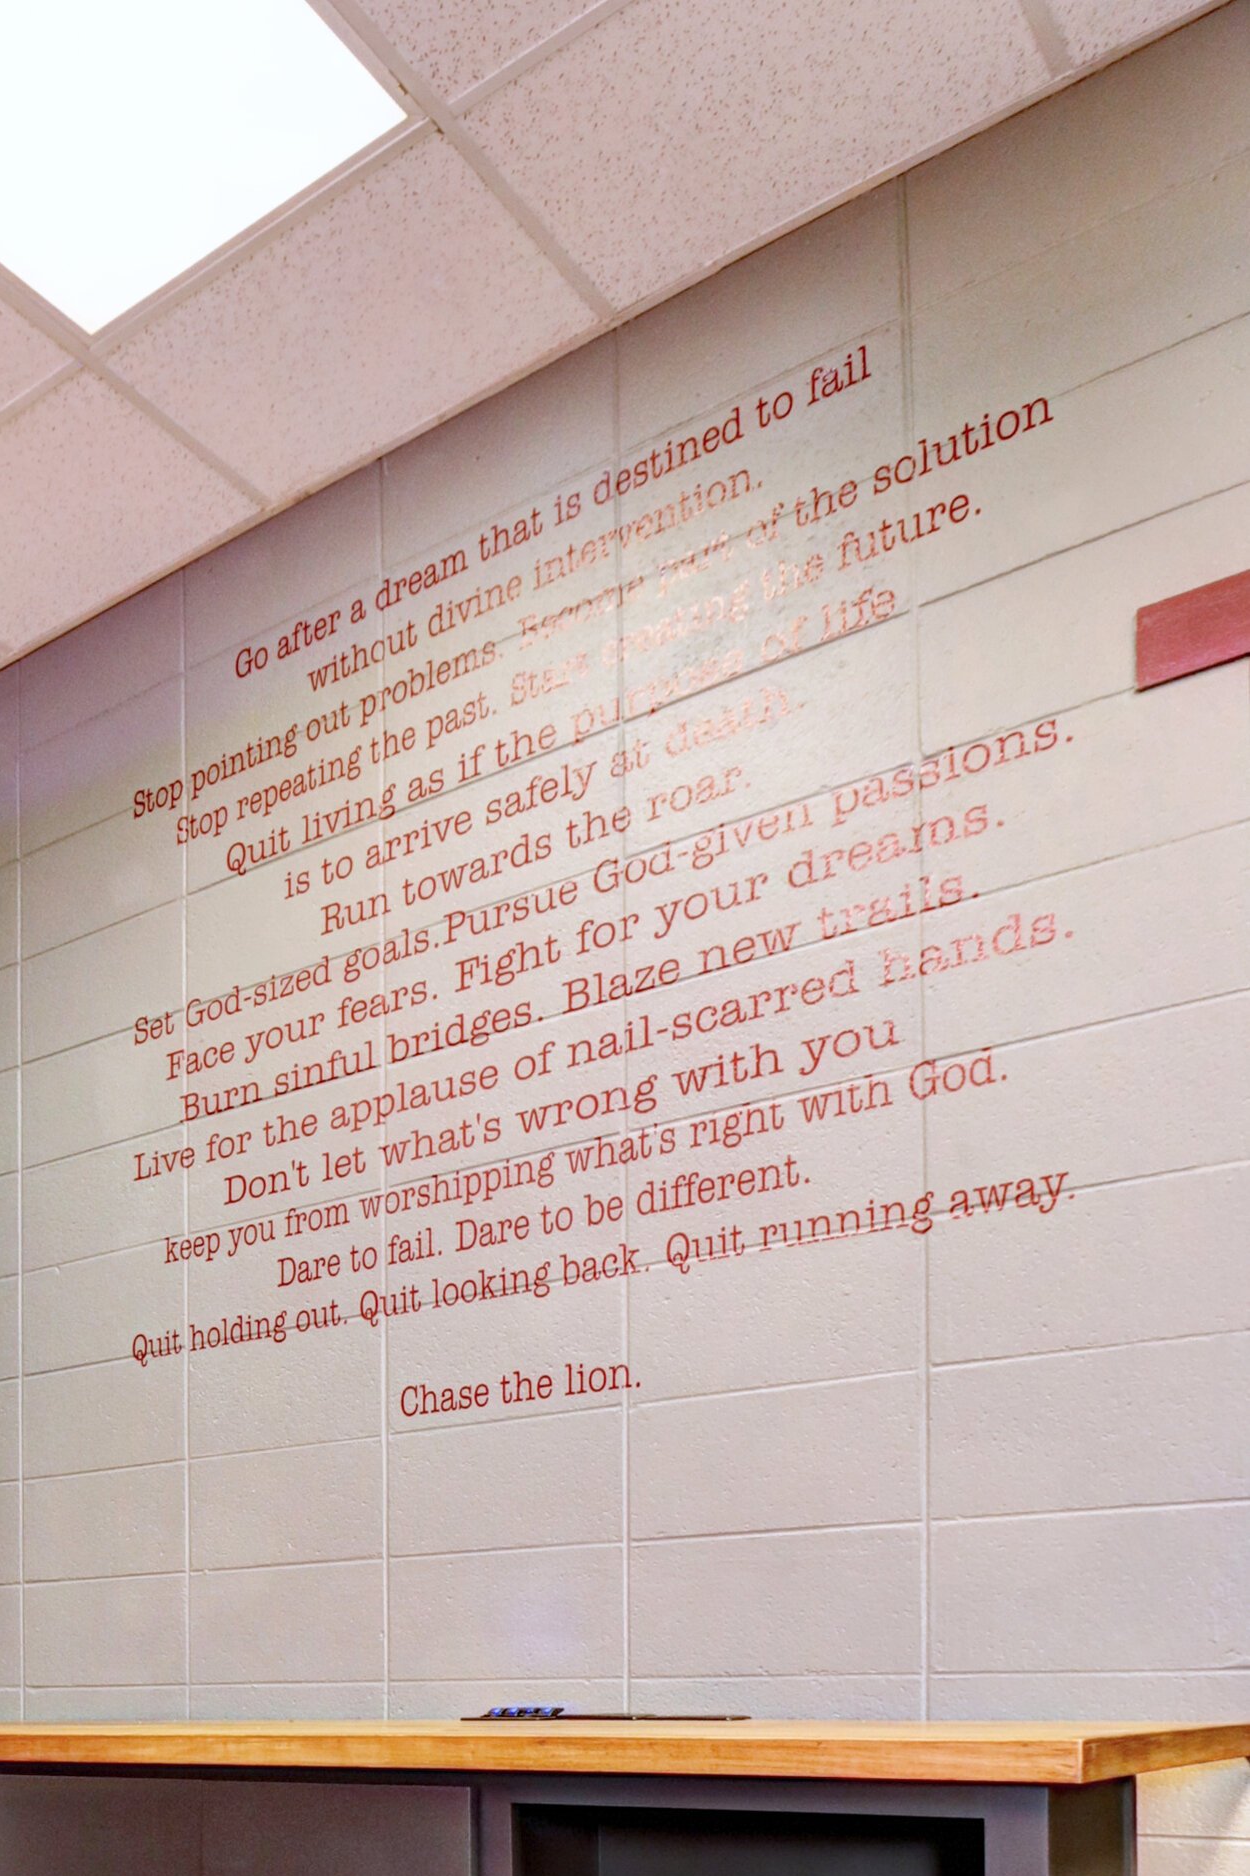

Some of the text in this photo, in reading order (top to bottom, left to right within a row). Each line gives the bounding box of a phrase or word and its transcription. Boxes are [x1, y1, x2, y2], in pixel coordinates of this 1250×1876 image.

[132, 775, 183, 819] Stop
[191, 729, 298, 790] pointing
[306, 701, 350, 741] out
[359, 641, 504, 727] problems.
[657, 530, 734, 596] part
[747, 502, 784, 548] of
[795, 479, 859, 527] the
[873, 396, 1053, 496] solution
[235, 346, 872, 678] Go after a dream that is destined to fail
[307, 467, 763, 691] without divine intervention.
[176, 492, 981, 846] Stop repeating the past. Start creating the future.
[226, 585, 896, 875] Quit living as if the purpose of life
[133, 1015, 175, 1046] Set
[184, 958, 332, 1026] God-sized
[593, 799, 814, 893] God-given
[830, 718, 1075, 827] passions.
[284, 685, 805, 899] is to arrive safely at death.
[320, 767, 751, 935] Run towards the roar.
[133, 911, 1075, 1181] Live for the applause of nail-scarred hands.
[166, 803, 1005, 1080] Face your fears. Fight for your dreams.
[180, 870, 981, 1124] Burn sinful bridges. Blaze new trails.
[163, 1045, 1008, 1265] keep you from worshipping what's right with God.
[223, 1019, 901, 1204] Don't let what's wrong with you
[277, 1153, 810, 1288] Dare to fail. Dare to be different.
[131, 1170, 1075, 1367] Quit holding out. Quit looking back. Quit running away.
[401, 1359, 641, 1418] Chase the lion.
